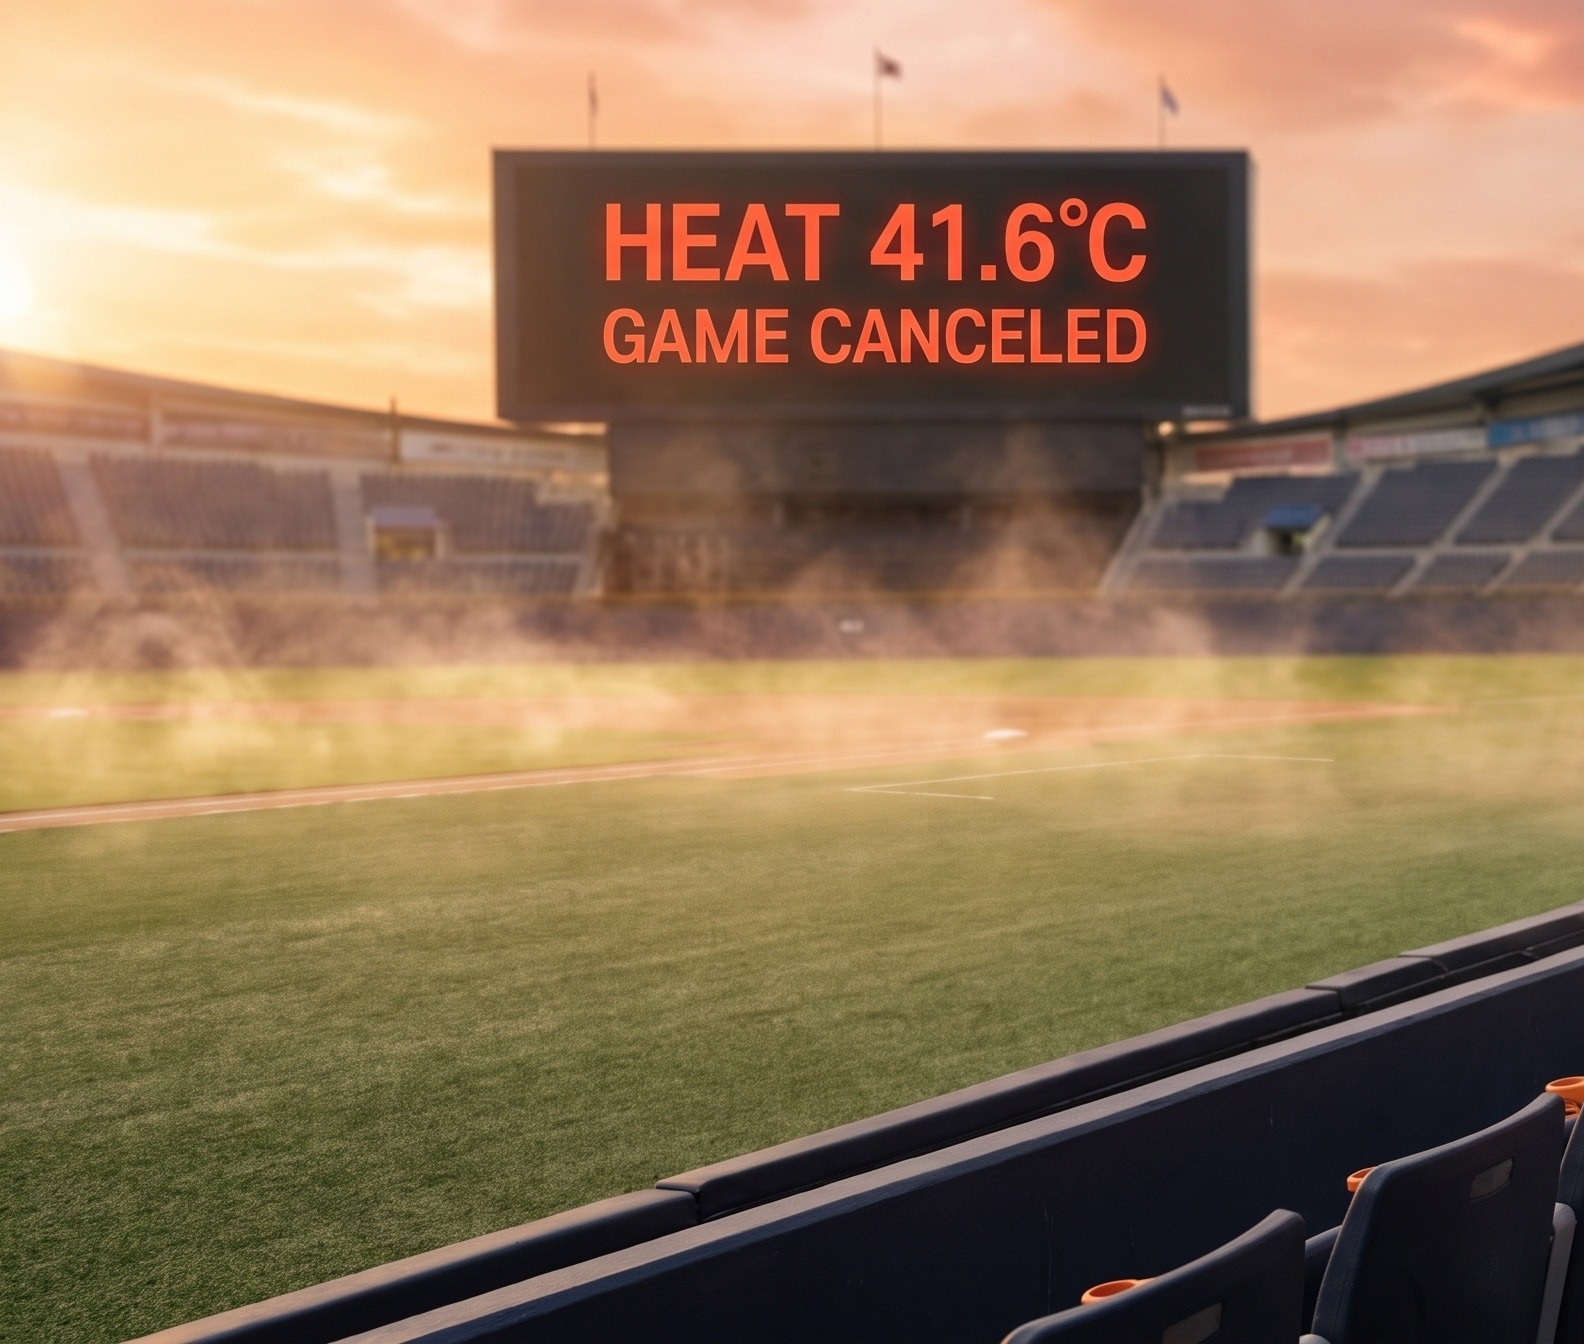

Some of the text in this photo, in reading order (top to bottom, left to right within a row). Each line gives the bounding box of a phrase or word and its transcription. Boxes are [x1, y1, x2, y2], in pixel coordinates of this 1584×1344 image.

[605, 198, 1147, 283] HEAT 41.6°C
[602, 307, 1147, 364] GAME CANCELED
